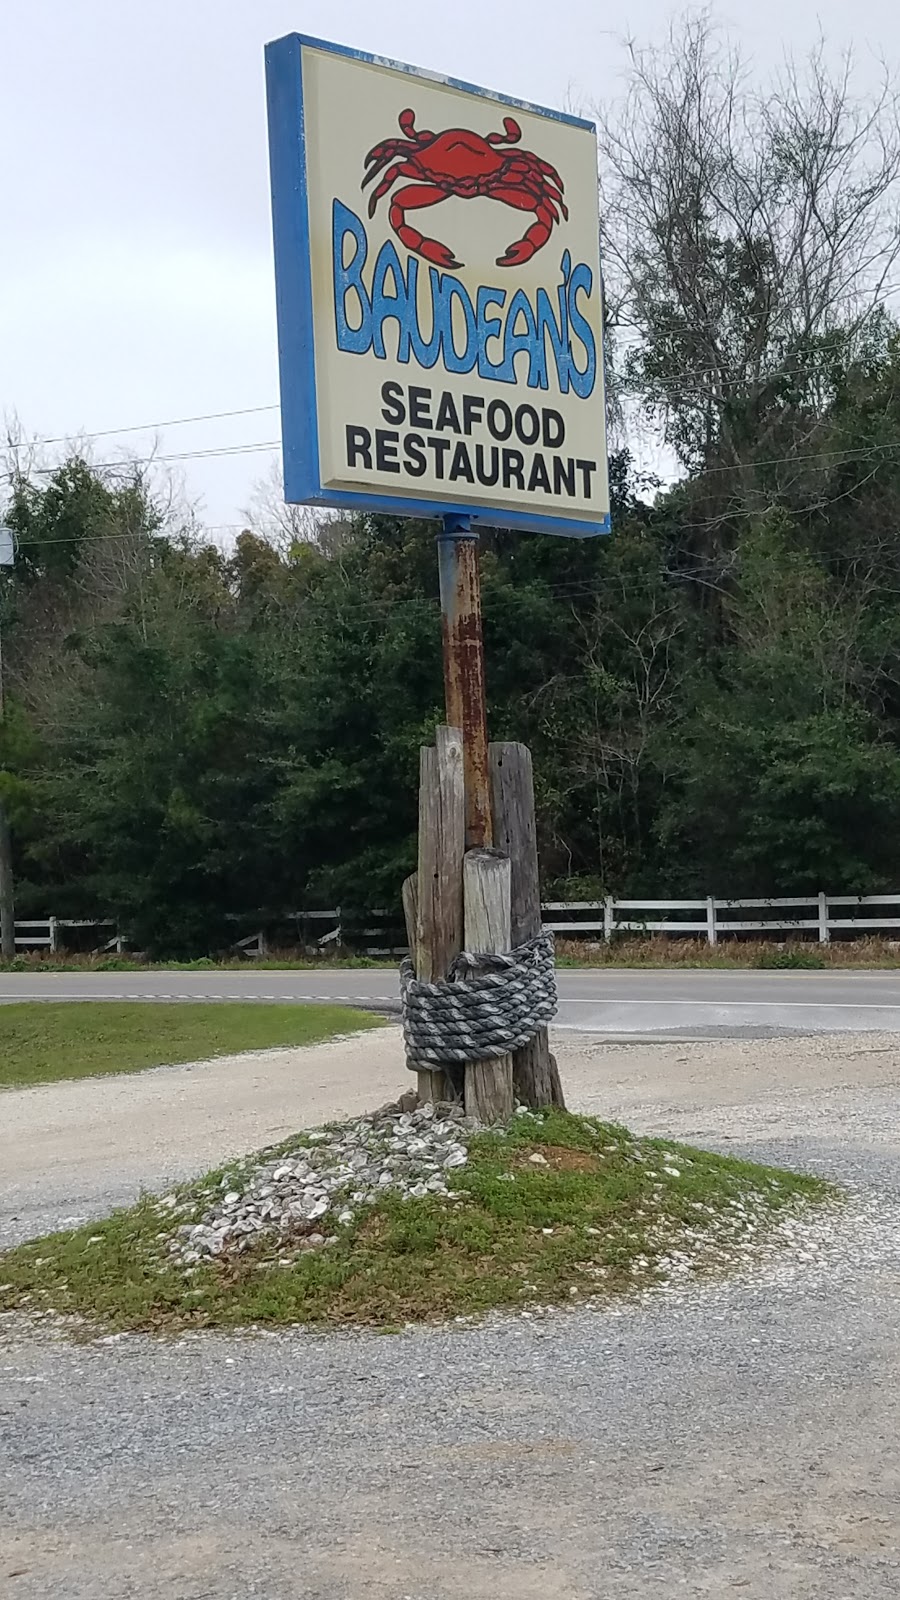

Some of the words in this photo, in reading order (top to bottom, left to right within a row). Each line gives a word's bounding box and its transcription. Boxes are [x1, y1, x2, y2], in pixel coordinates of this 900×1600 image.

[332, 197, 596, 399] BAUDEAN'S
[380, 381, 565, 449] SEAFOOD
[345, 424, 597, 499] RESTAURANT
